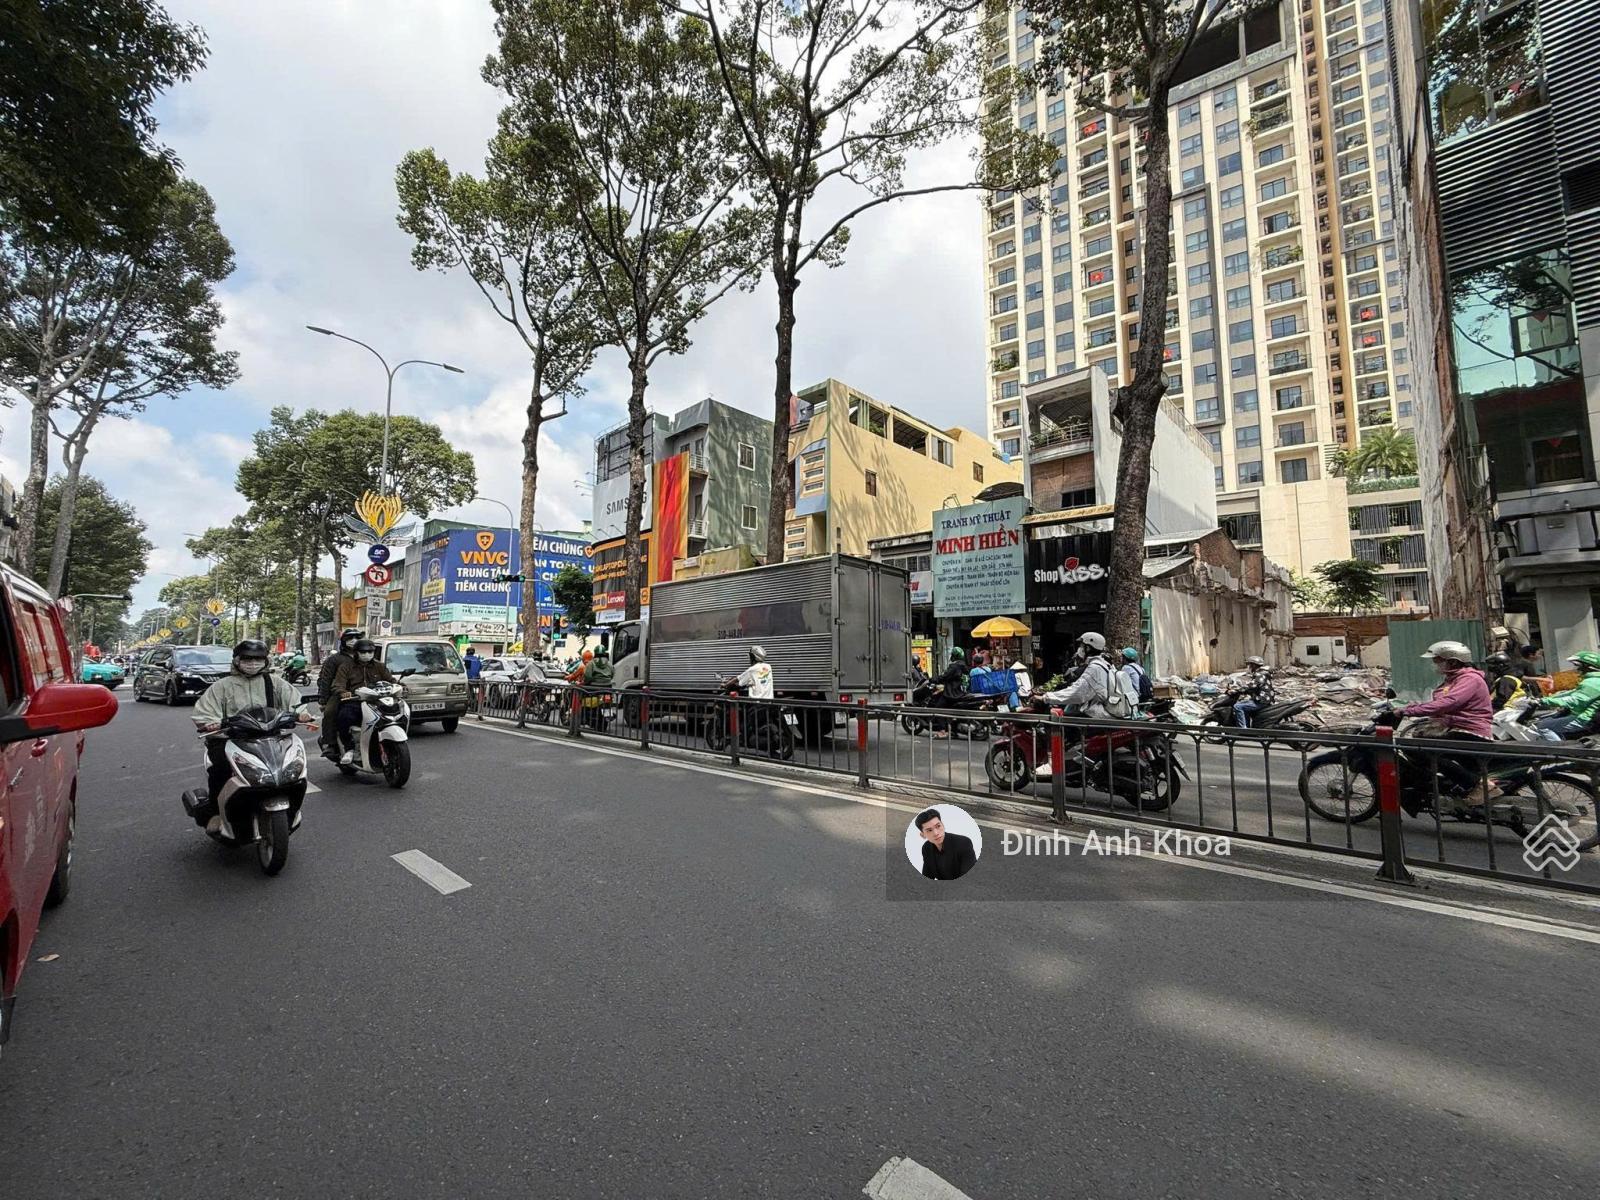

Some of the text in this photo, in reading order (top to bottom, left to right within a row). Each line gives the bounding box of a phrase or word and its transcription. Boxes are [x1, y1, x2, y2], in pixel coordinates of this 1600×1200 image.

[606, 492, 648, 515] SAMSG
[942, 517, 968, 530] TRANH
[982, 510, 1011, 523] THUẬT
[936, 524, 1019, 555] MINH HIỀN
[460, 550, 508, 566] VNVC
[457, 568, 489, 578] TRUNG
[1034, 570, 1058, 584] Shop
